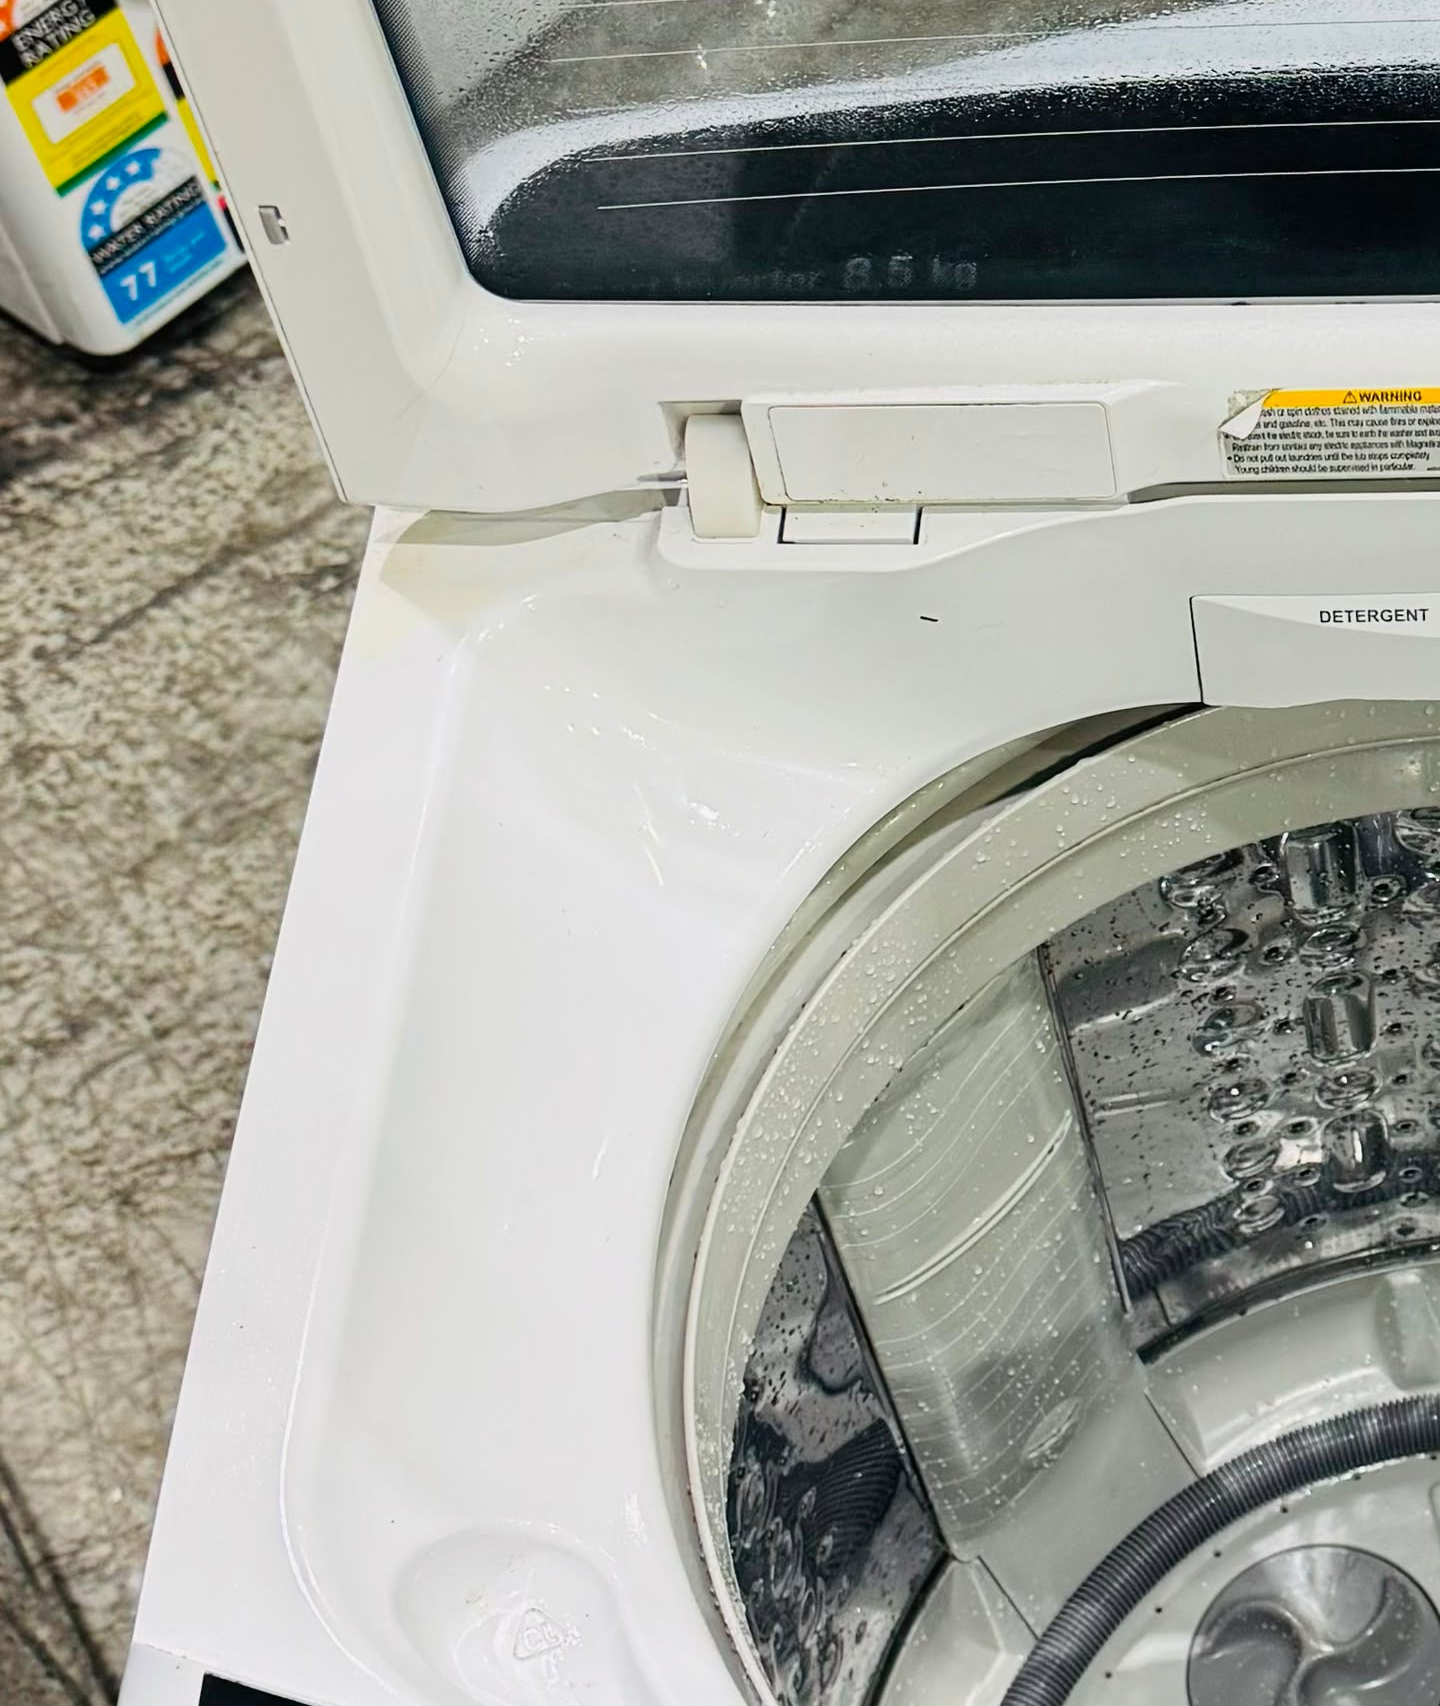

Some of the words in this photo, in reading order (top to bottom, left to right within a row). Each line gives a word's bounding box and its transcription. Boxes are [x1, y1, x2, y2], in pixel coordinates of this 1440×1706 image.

[20, 9, 96, 69] RATING
[91, 221, 145, 264] WATER
[120, 260, 157, 301] 77
[1359, 391, 1422, 403] WARNING
[1319, 607, 1429, 625] DETERGENT
